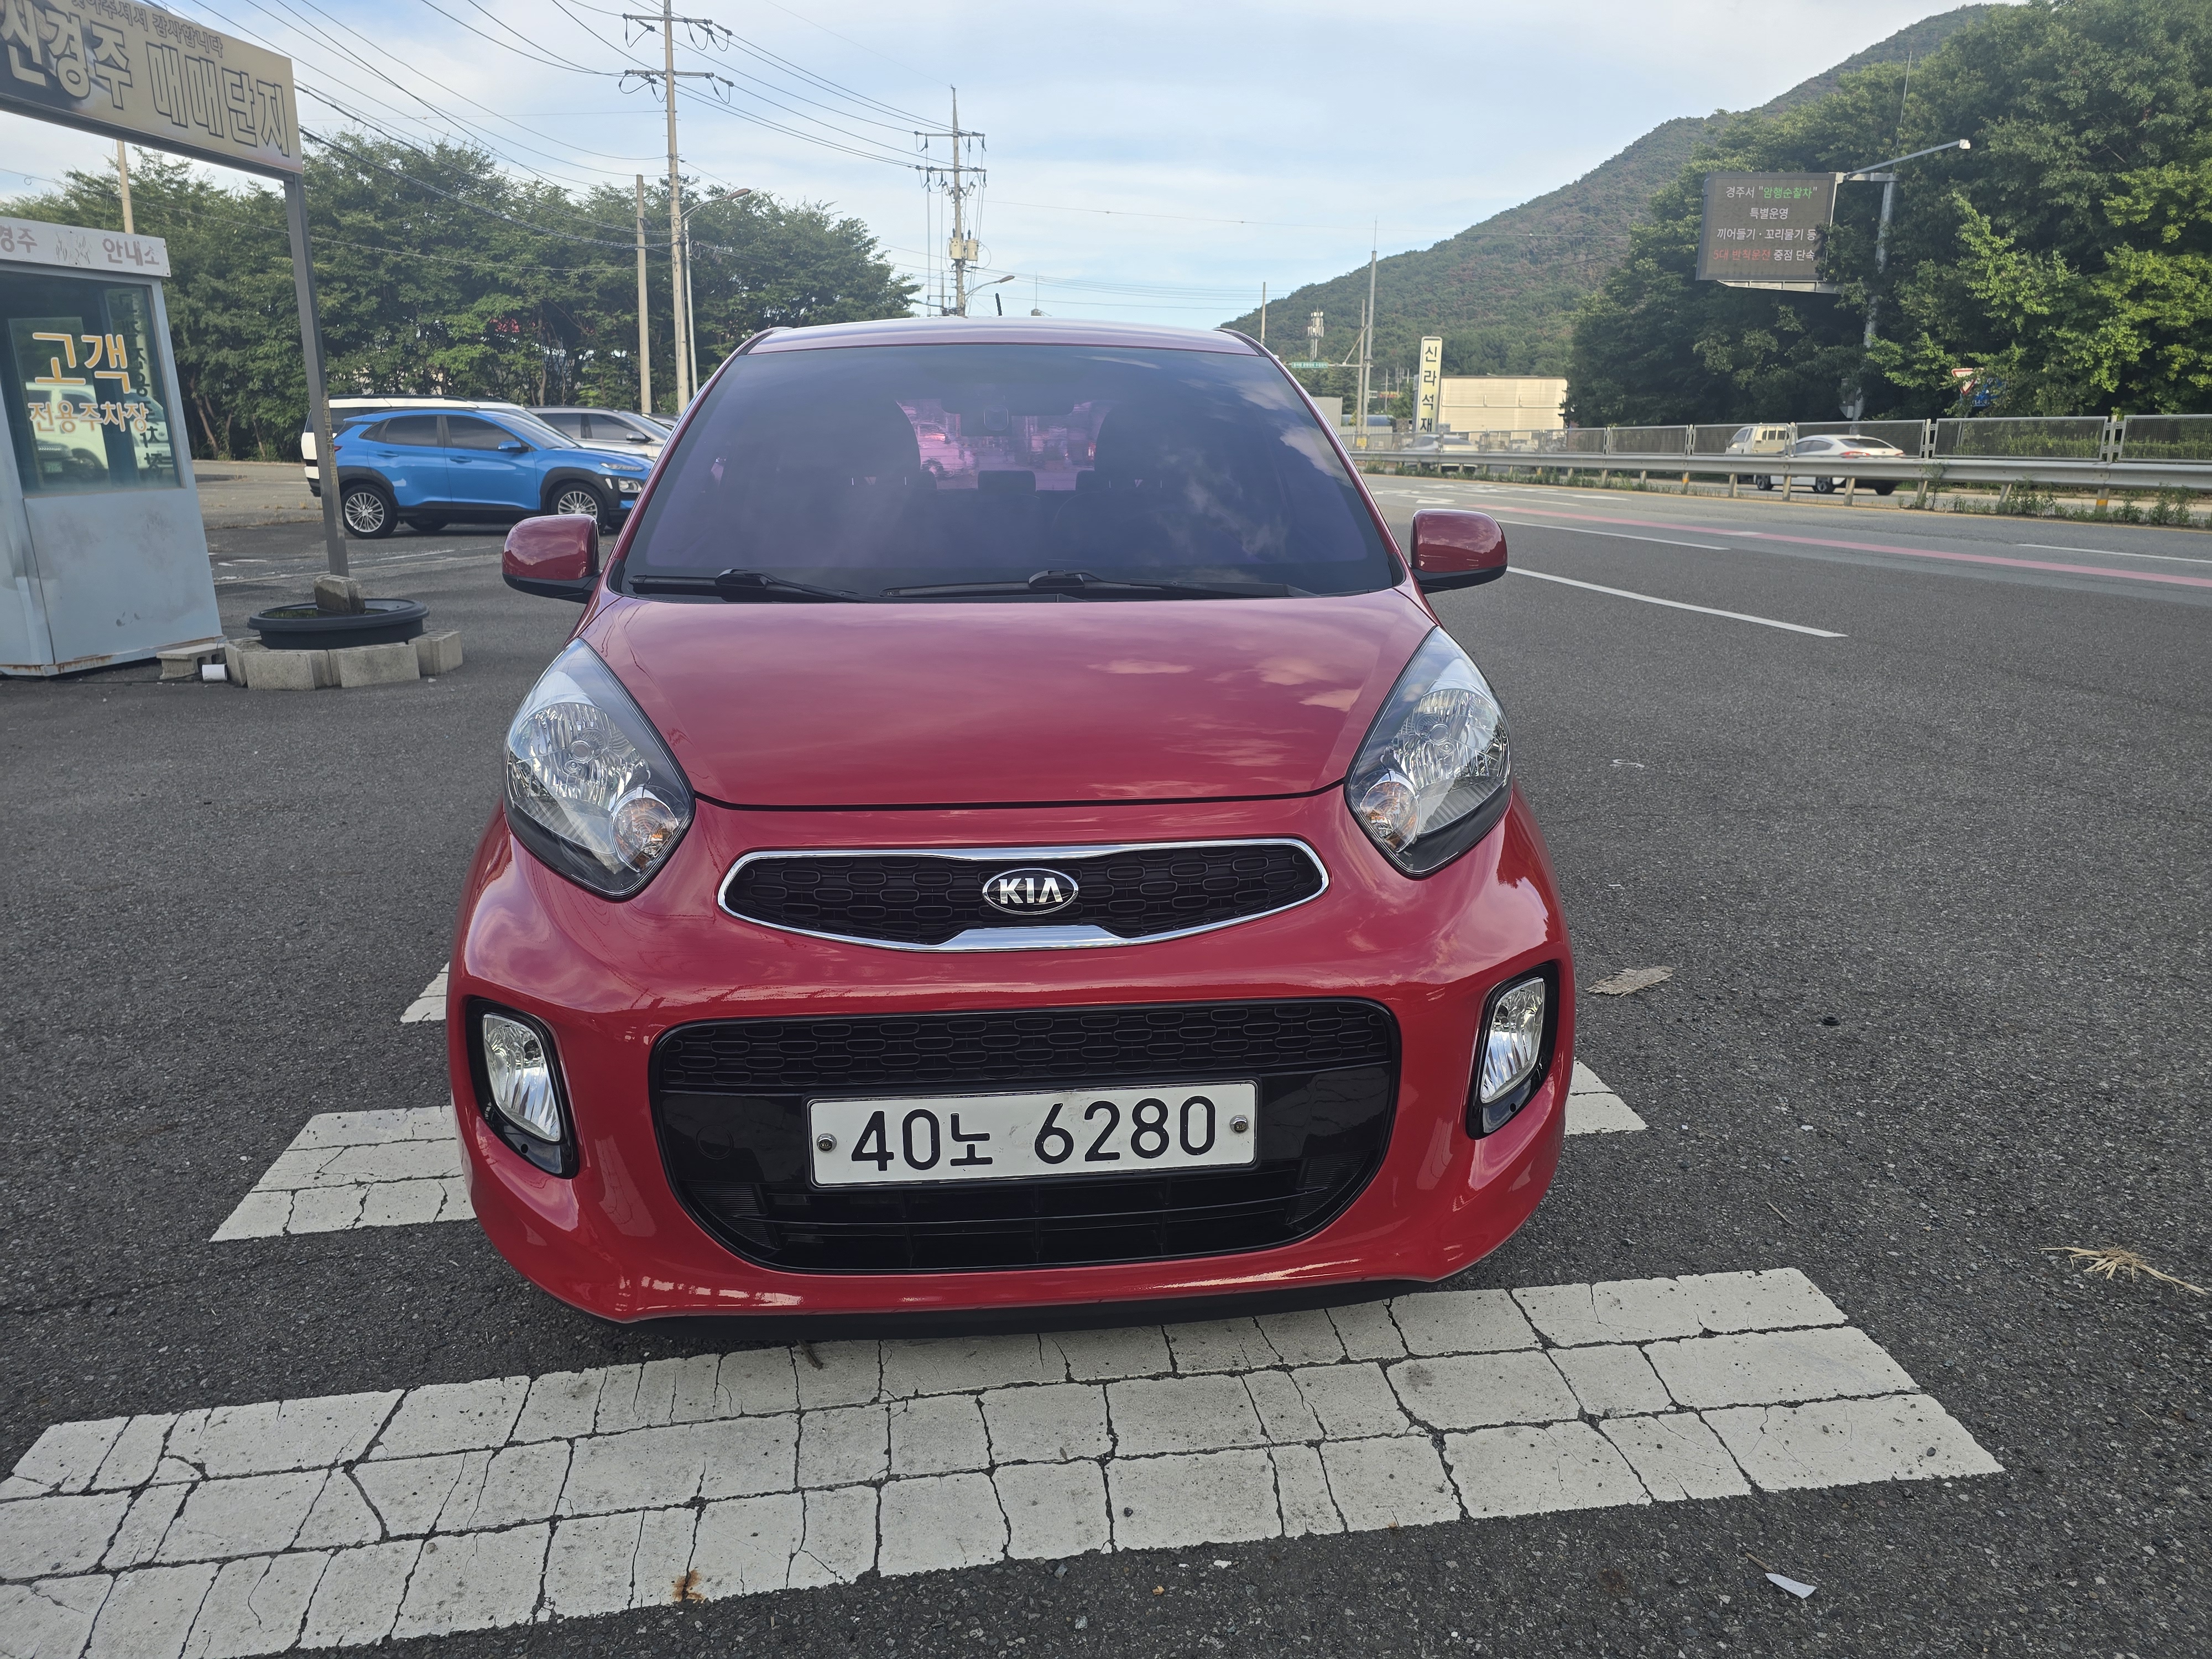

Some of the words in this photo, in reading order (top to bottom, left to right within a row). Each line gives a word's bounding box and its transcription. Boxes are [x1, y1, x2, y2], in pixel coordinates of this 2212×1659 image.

[152, 13, 223, 59] 감사합니다
[0, 0, 133, 110] 신경주
[145, 41, 290, 158] 매매단지
[1725, 186, 1755, 199] 경주서
[1759, 186, 1818, 199] "암행순찰차"
[1749, 207, 1789, 220] 특별운영
[1717, 228, 1756, 241] 끼어들기
[1764, 228, 1803, 241] 꼬리물기
[1807, 229, 1817, 241] 등
[102, 237, 160, 267] 안내소
[1713, 249, 1729, 261] 5대
[1732, 249, 1771, 261] 반칙운전
[1773, 249, 1793, 261] 중점
[1796, 249, 1815, 261] 단속
[33, 332, 131, 394] 고객
[1420, 346, 1437, 432] 신라석재
[28, 400, 149, 433] 전용주차장
[998, 877, 1063, 904] KIA
[851, 1108, 993, 1171] 40노
[1034, 1095, 1216, 1165] 6280
